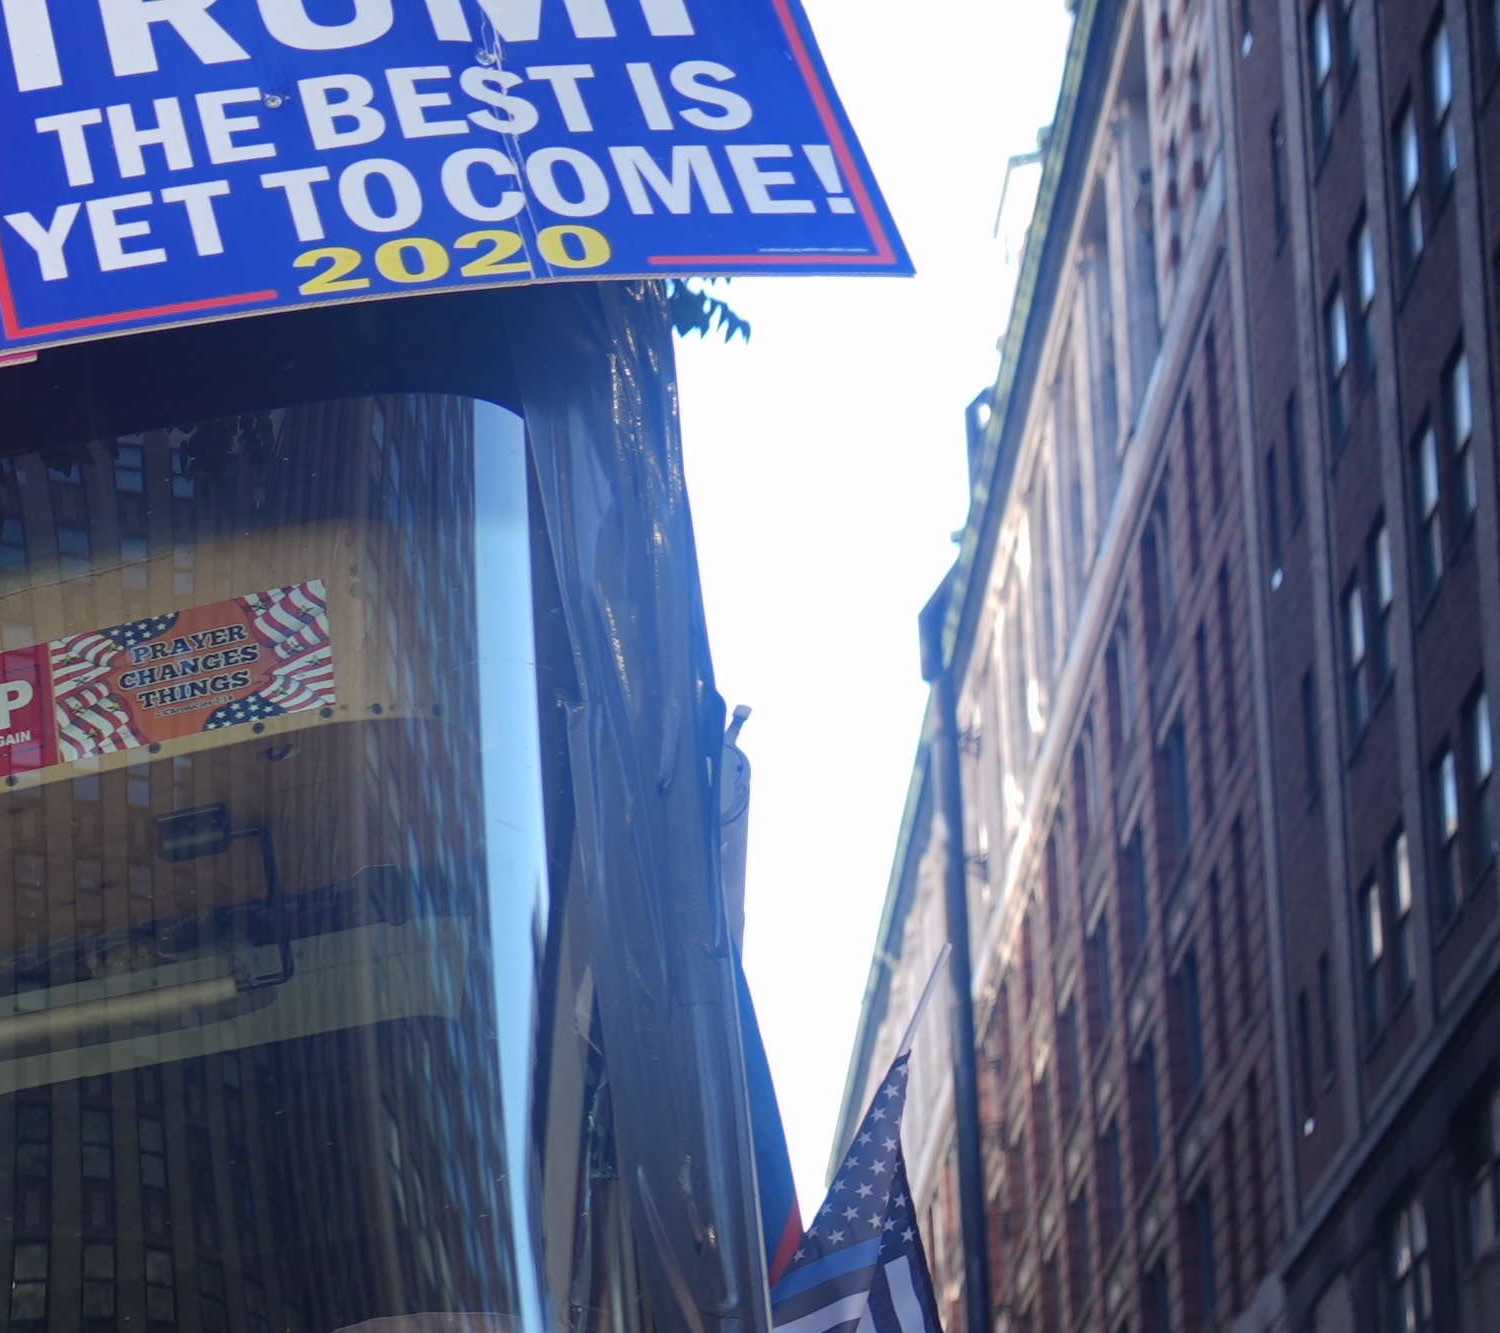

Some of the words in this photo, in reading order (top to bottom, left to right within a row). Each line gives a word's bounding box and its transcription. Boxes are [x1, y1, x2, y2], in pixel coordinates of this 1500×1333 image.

[35, 86, 276, 187] THE
[299, 61, 596, 151] BEST
[626, 60, 753, 133] IS
[4, 182, 231, 283] YET
[262, 157, 423, 242] TO
[440, 143, 856, 224] COME!
[291, 223, 612, 296] 2020
[118, 643, 260, 689] CHANGES
[132, 623, 248, 665] PRAYER
[137, 669, 250, 711] THINGS
